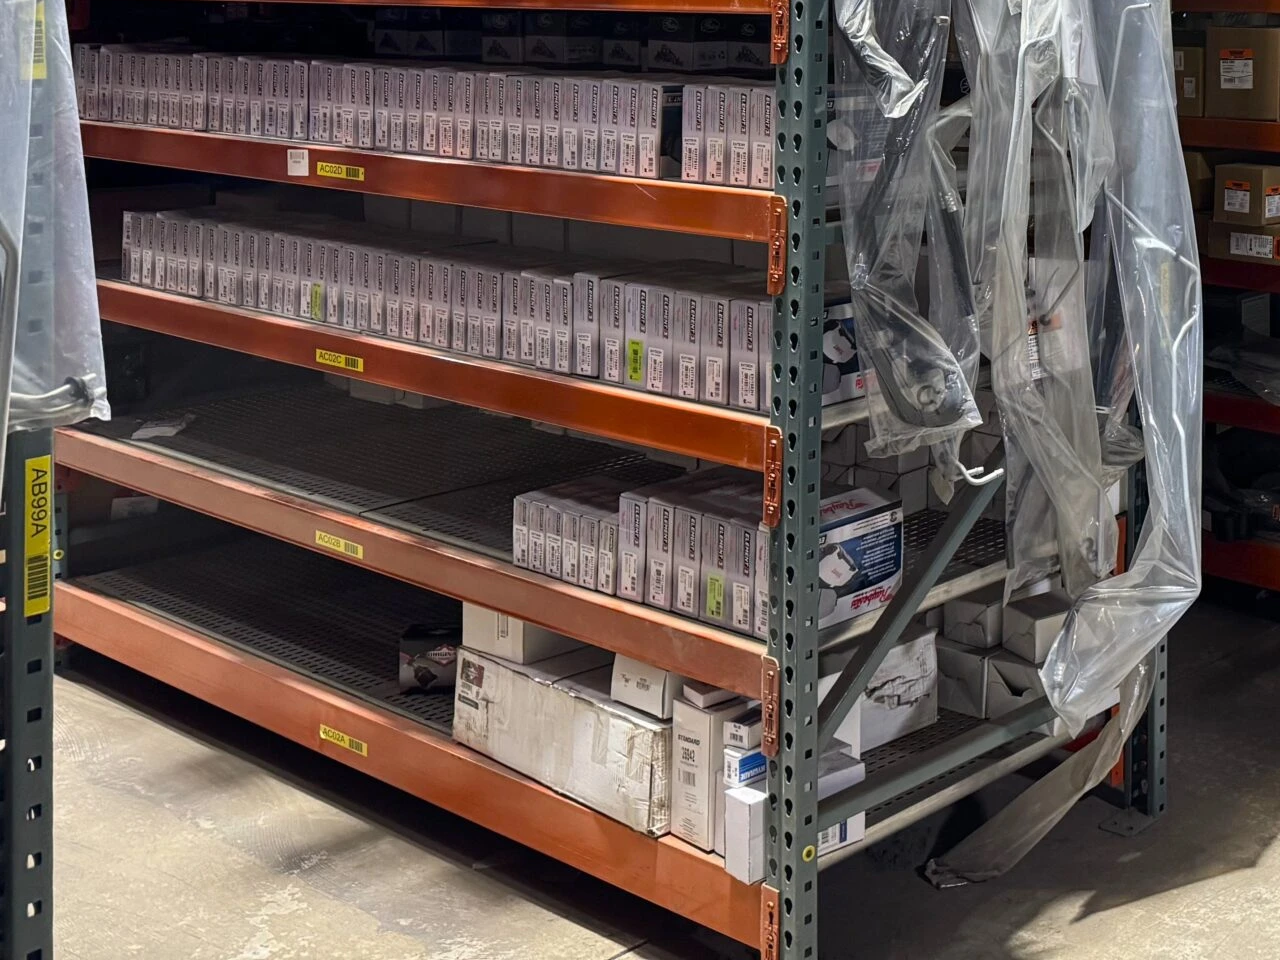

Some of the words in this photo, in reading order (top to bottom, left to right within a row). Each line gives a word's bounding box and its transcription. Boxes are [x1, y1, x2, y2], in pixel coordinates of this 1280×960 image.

[319, 163, 343, 175] AC02D
[318, 351, 342, 364] AC02C
[30, 467, 48, 539] AB99A
[318, 532, 341, 548] AC02B
[322, 726, 346, 744] AC02A
